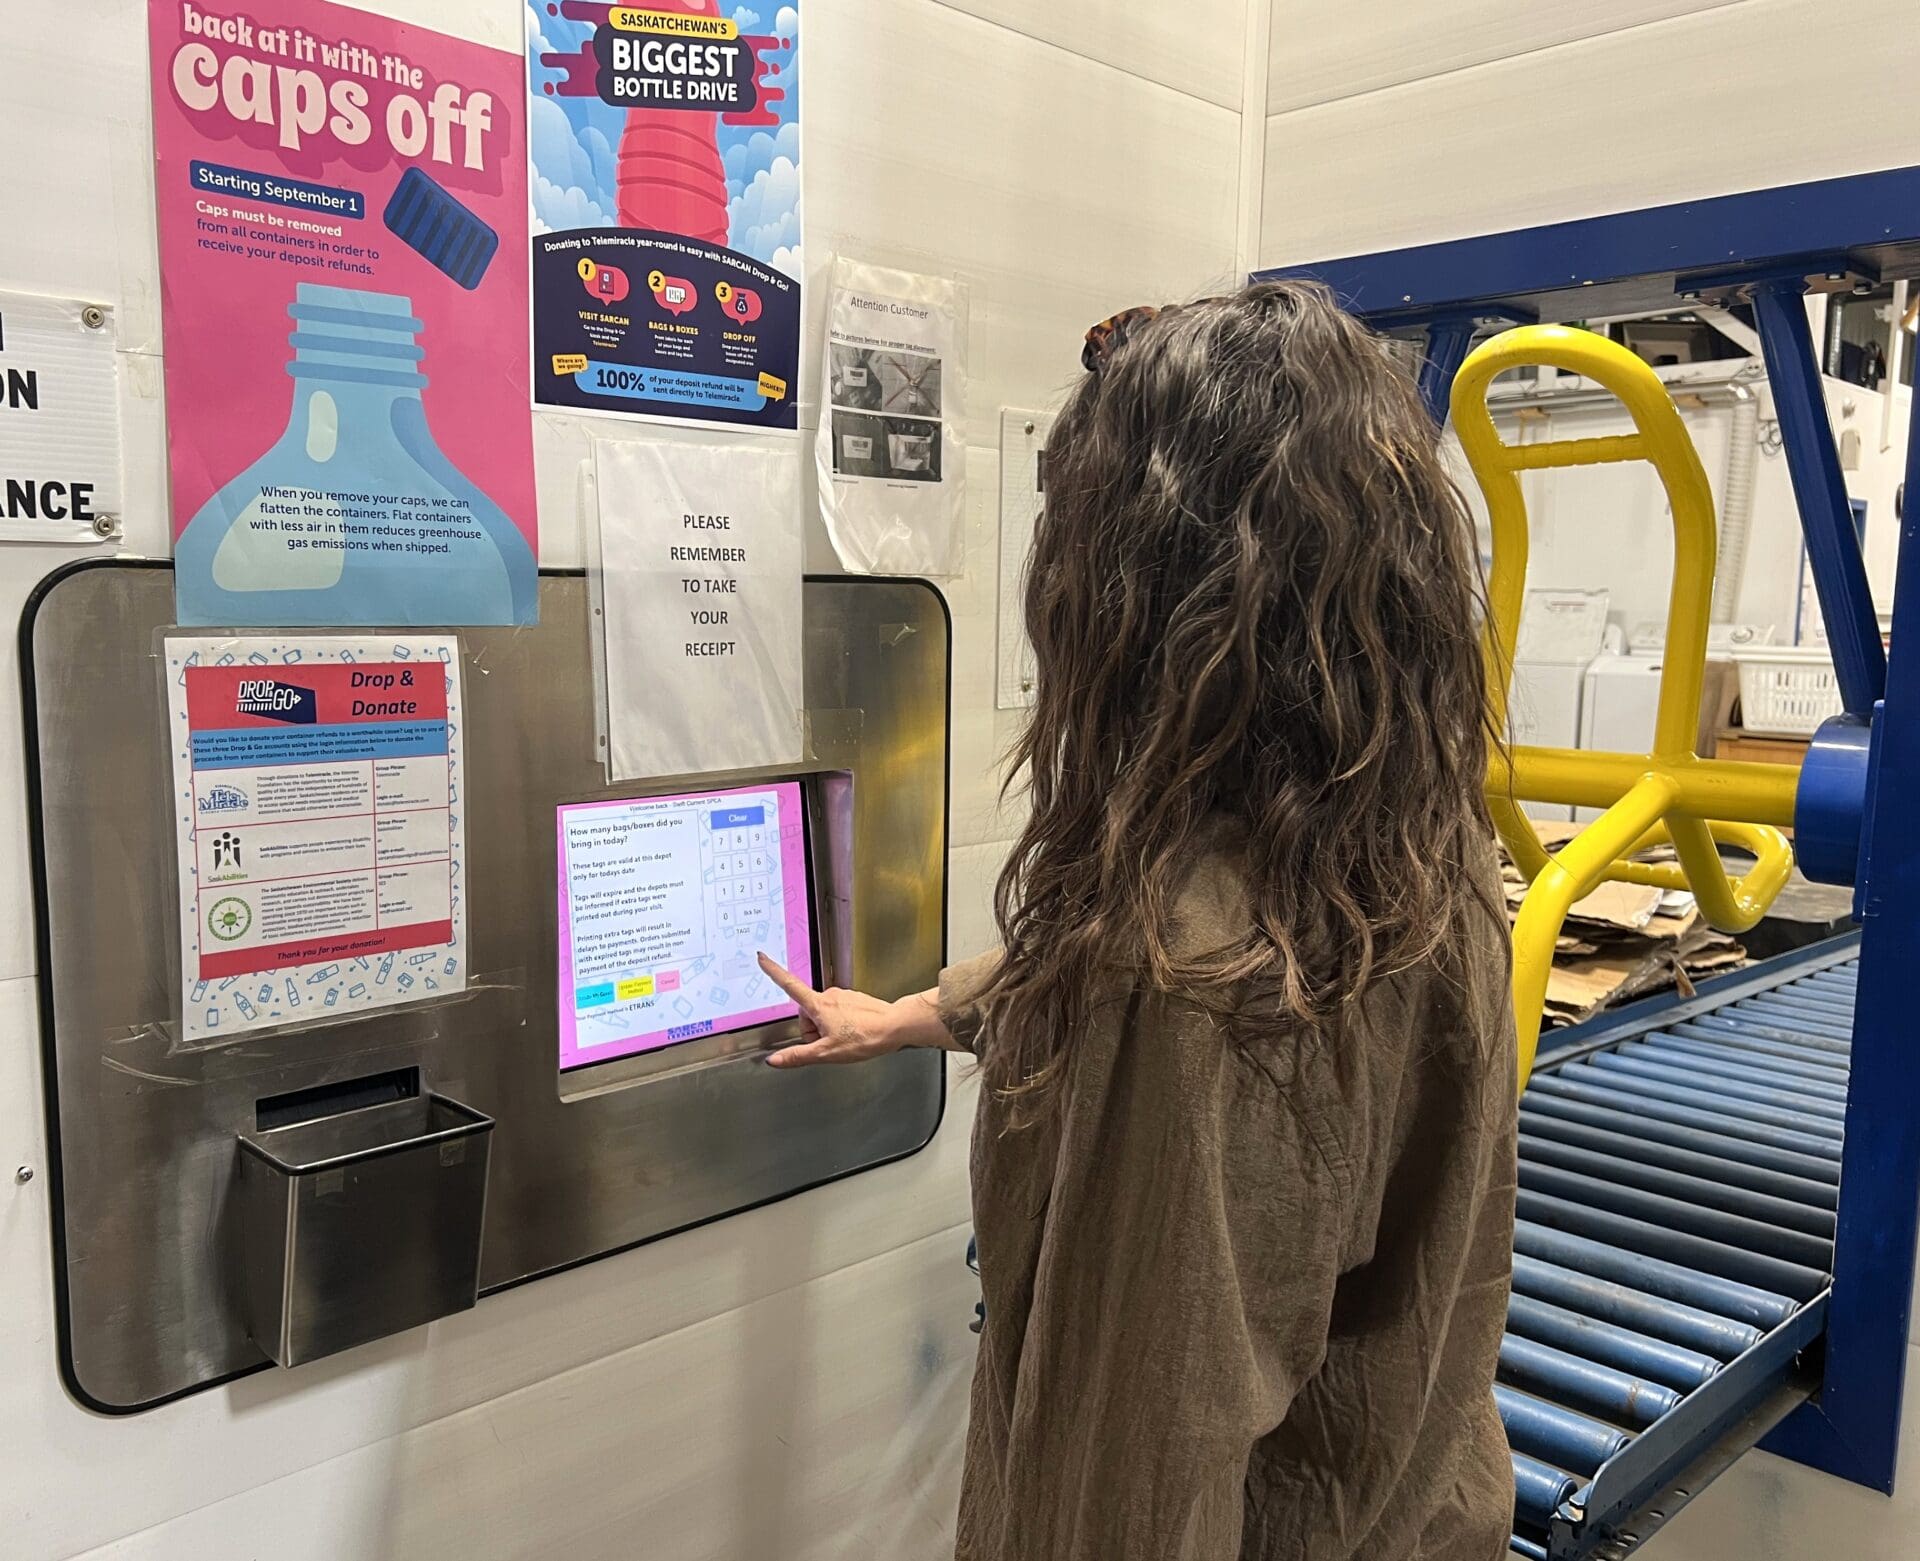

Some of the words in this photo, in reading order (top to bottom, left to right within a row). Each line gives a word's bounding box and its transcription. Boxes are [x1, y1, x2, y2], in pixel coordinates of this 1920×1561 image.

[621, 13, 727, 34] SASKATCHEWAN'S
[184, 4, 252, 47] back
[258, 29, 289, 55] at
[294, 30, 316, 62] it
[321, 42, 377, 78] with
[382, 56, 423, 89] the
[612, 38, 739, 78] BIGGEST
[614, 77, 682, 100] BOTTLE
[687, 81, 738, 102] DRIVE
[172, 42, 371, 151] caps
[386, 83, 492, 172] off
[199, 168, 260, 196] Starting
[265, 182, 345, 208] September
[349, 198, 357, 212] 1
[196, 200, 228, 217] Caps
[232, 210, 265, 223] must
[268, 213, 284, 227] be
[287, 220, 342, 236] removed
[197, 218, 228, 234] from
[232, 226, 247, 237] all
[250, 231, 315, 249] containers
[318, 239, 329, 252] in
[332, 244, 364, 257] order
[367, 249, 379, 259] to
[198, 239, 243, 254] receive
[247, 247, 276, 259] your
[279, 251, 324, 267] deposit
[328, 260, 374, 275] refunds.
[544, 238, 581, 252] Donating
[582, 238, 590, 246] to
[591, 236, 635, 246] Telemiracle
[637, 237, 678, 250] year-round
[679, 243, 686, 252] is
[687, 247, 703, 259] easy
[704, 249, 720, 262] with
[722, 254, 751, 273] SARCAN
[752, 266, 769, 283] Drop
[770, 276, 776, 284] &
[777, 278, 789, 292] Go!
[584, 264, 589, 275] 1
[652, 276, 661, 287] 2
[719, 287, 727, 298] 3
[850, 296, 888, 313] Attention
[890, 304, 928, 320] Customer
[579, 310, 598, 321] VISIT
[600, 314, 630, 325] SARCAN
[648, 321, 668, 331] BAGS
[676, 324, 699, 335] BOXES
[723, 332, 741, 341] DROP
[743, 335, 756, 343] OFF
[597, 369, 645, 392] 100%
[675, 378, 700, 388] deposit
[702, 382, 723, 391] refund
[724, 384, 737, 392] will
[737, 385, 744, 393] be
[669, 388, 694, 398] directly
[705, 391, 740, 402] Telemiracle.
[261, 486, 297, 498] When
[300, 491, 322, 502] you
[326, 492, 369, 502] remove
[372, 495, 398, 506] your
[401, 497, 428, 507] caps,
[432, 499, 447, 507] we
[450, 500, 469, 508] can
[260, 502, 300, 515] flatten
[304, 505, 323, 516] the
[326, 508, 389, 519] containers.
[393, 509, 412, 520] Flat
[416, 513, 471, 523] containers
[250, 520, 277, 530] with
[281, 520, 304, 531] less
[307, 522, 322, 532] air
[325, 522, 336, 533] in
[339, 523, 369, 534] them
[372, 525, 415, 536] reduces
[419, 528, 481, 539] greenhouse
[683, 515, 730, 530] PLEASE
[287, 539, 308, 550] gas
[311, 538, 368, 550] emissions
[371, 541, 402, 551] when
[406, 542, 451, 554] shipped.
[670, 547, 746, 562] REMEMBER
[682, 579, 700, 593] TO
[704, 579, 736, 593] TAKE
[691, 611, 728, 625] YOUR
[685, 642, 735, 656] RECEIPT
[351, 672, 394, 690] Drop
[400, 670, 414, 686] &
[238, 680, 274, 698] DROP
[273, 688, 294, 710] GO
[352, 700, 416, 716] Donate
[570, 828, 588, 836] How
[613, 822, 654, 832] bags/boxes
[656, 819, 668, 827] did
[571, 841, 592, 849] bring
[603, 835, 628, 845] today?
[654, 852, 672, 860] depot
[574, 894, 589, 902] Tags
[590, 891, 602, 899] will
[603, 890, 622, 898] expire
[648, 883, 668, 891] depots
[740, 885, 744, 893] 2
[584, 900, 614, 910] informed
[278, 950, 301, 960] Thank
[303, 950, 317, 958] you
[317, 946, 330, 956] for
[331, 944, 348, 954] your
[350, 937, 386, 949] donation!
[629, 1001, 655, 1011] ETRANS
[667, 1019, 713, 1035] SARCAN
